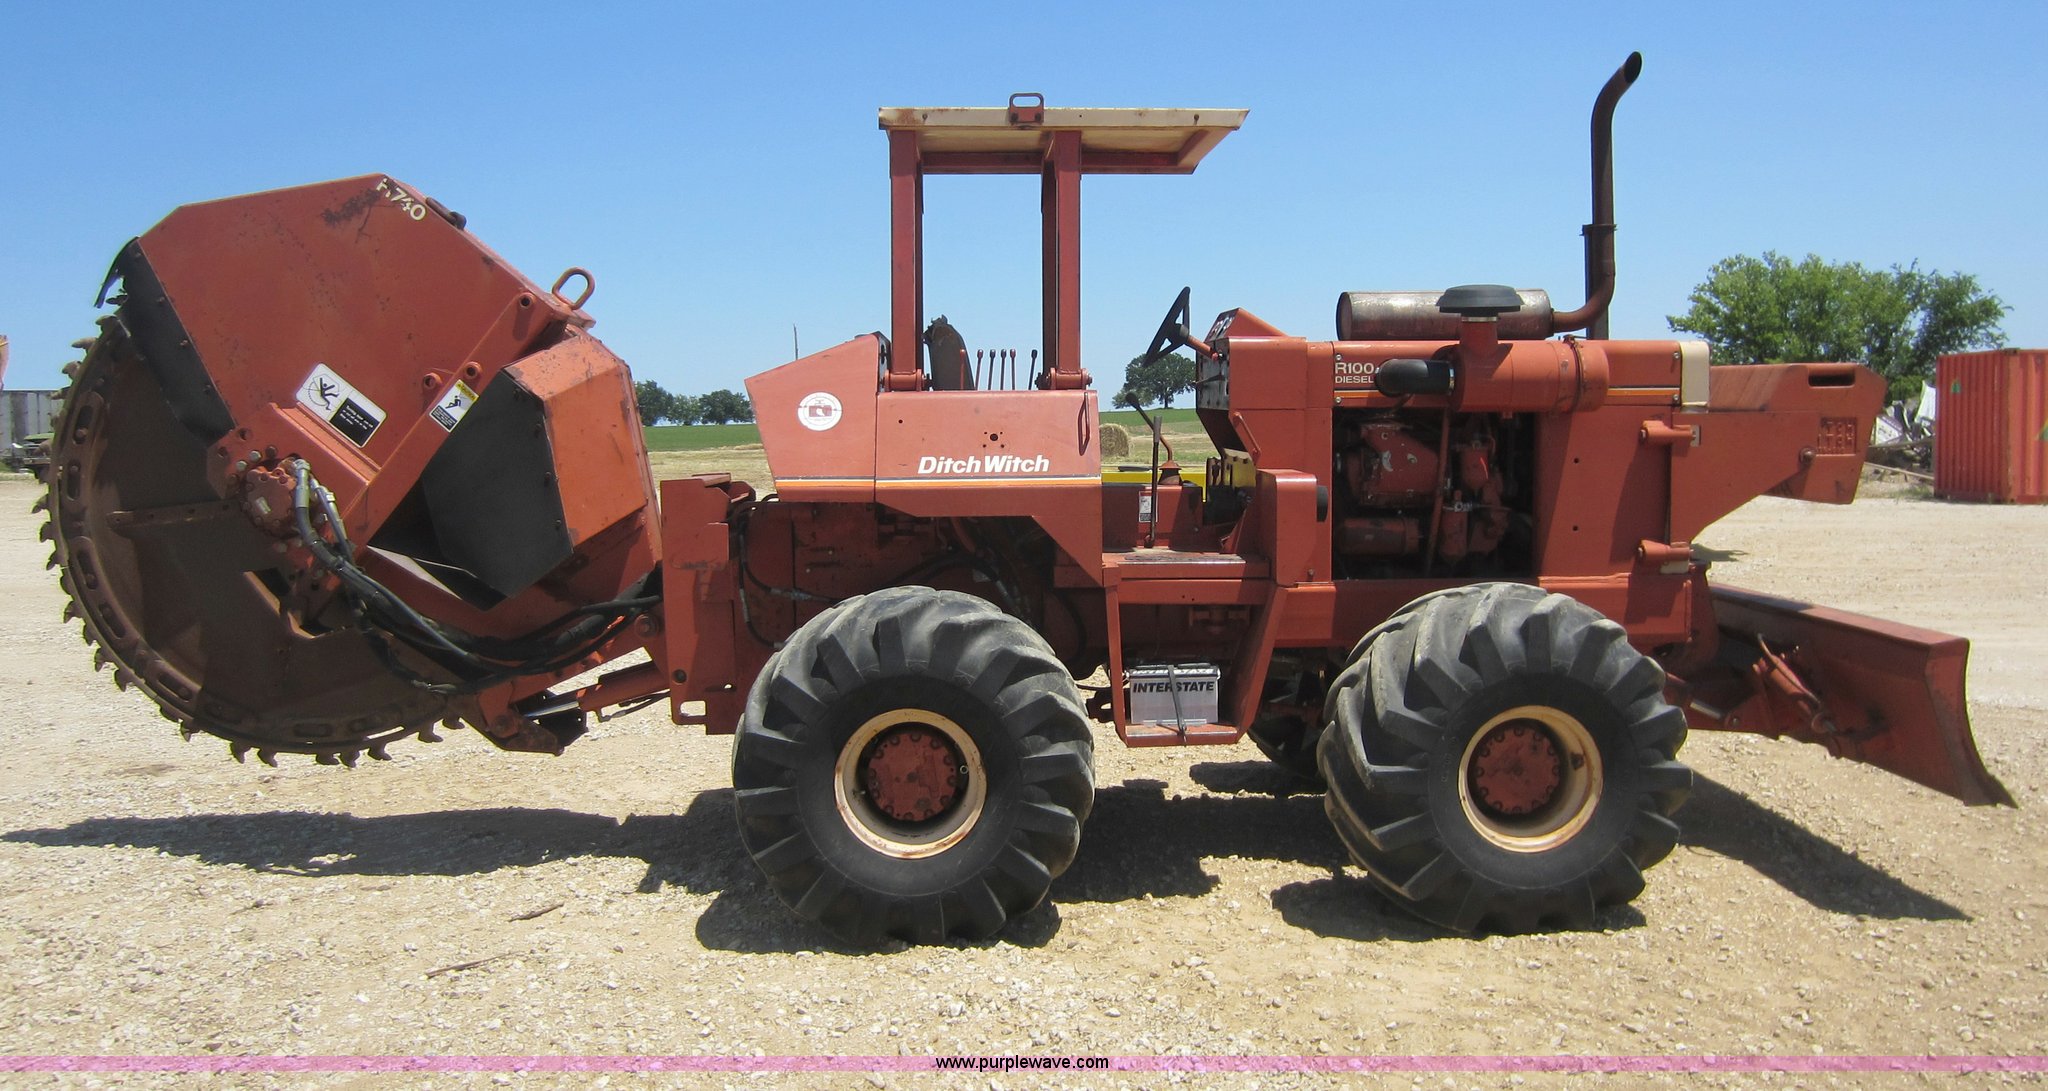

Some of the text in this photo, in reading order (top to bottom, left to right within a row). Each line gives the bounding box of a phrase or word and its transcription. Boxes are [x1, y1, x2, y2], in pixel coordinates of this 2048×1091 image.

[1335, 362, 1374, 374] R100
[1335, 375, 1374, 384] DIESEL
[918, 455, 1049, 474] Ditch Witch
